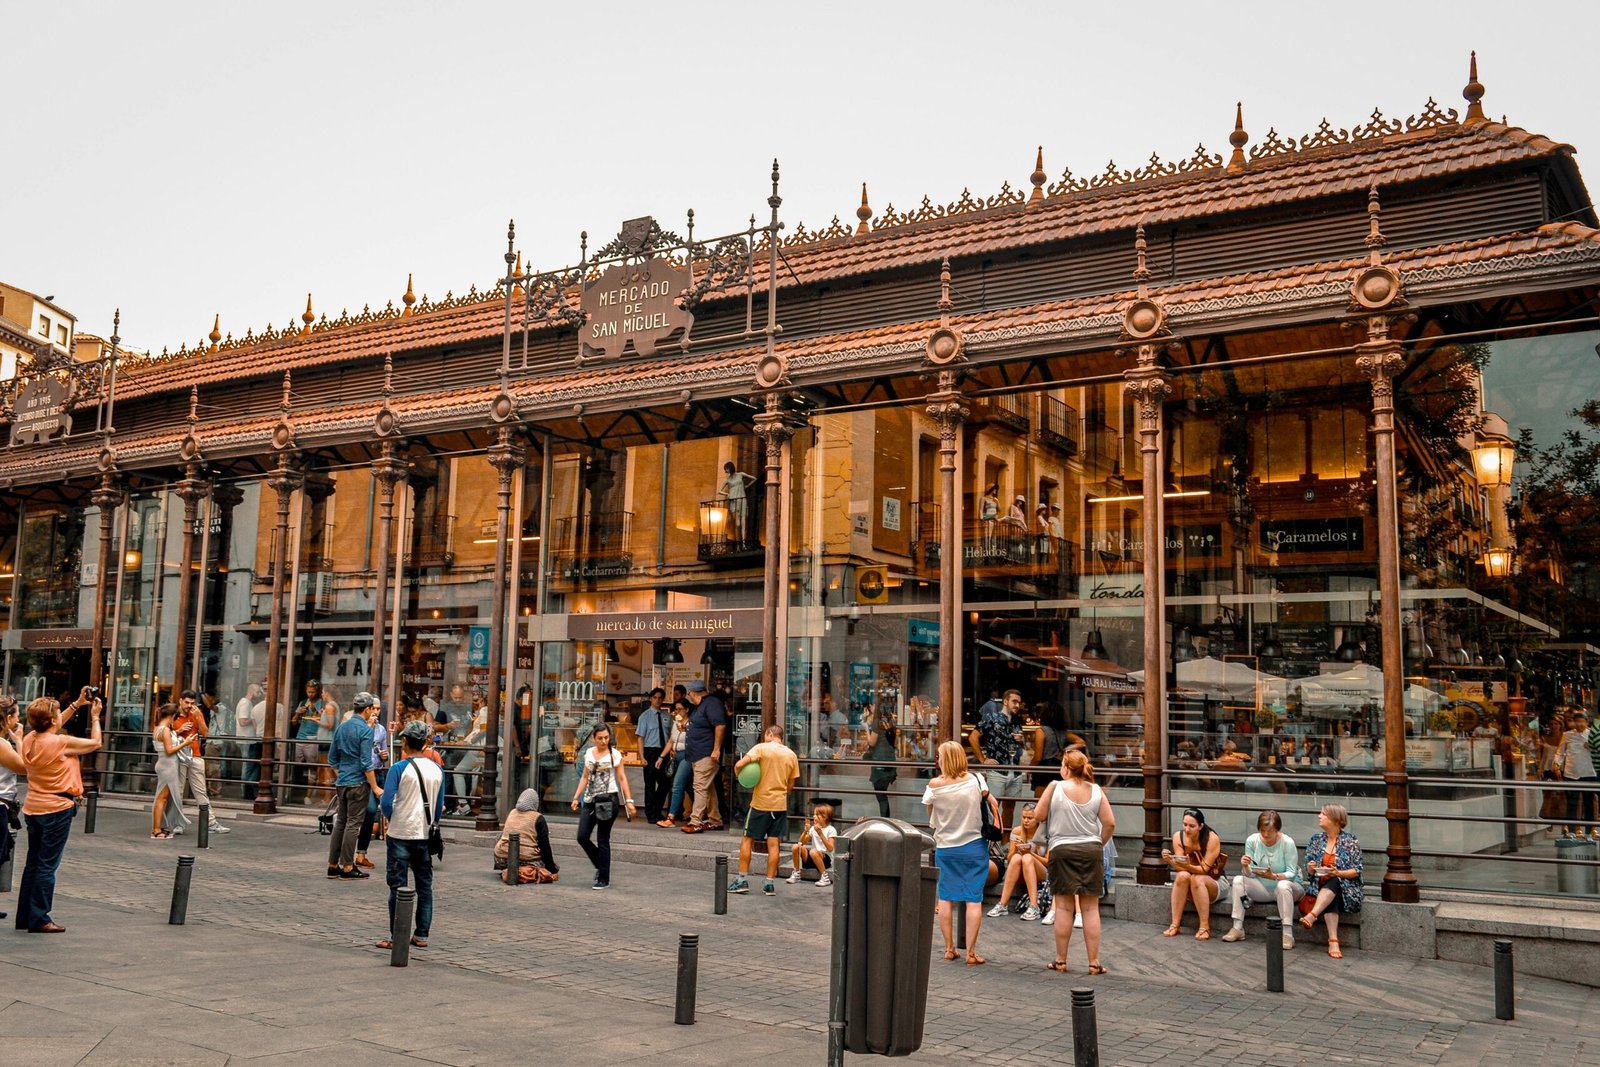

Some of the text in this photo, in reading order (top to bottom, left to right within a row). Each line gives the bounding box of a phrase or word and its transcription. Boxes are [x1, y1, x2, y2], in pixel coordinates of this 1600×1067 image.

[599, 280, 670, 307] MERCADO
[624, 303, 643, 315] DE
[592, 320, 618, 339] SAN
[1119, 536, 1184, 551] Caralos
[1276, 528, 1348, 544] Caramelos
[964, 545, 1007, 558] Helados
[596, 613, 733, 634] mercado de san miguel
